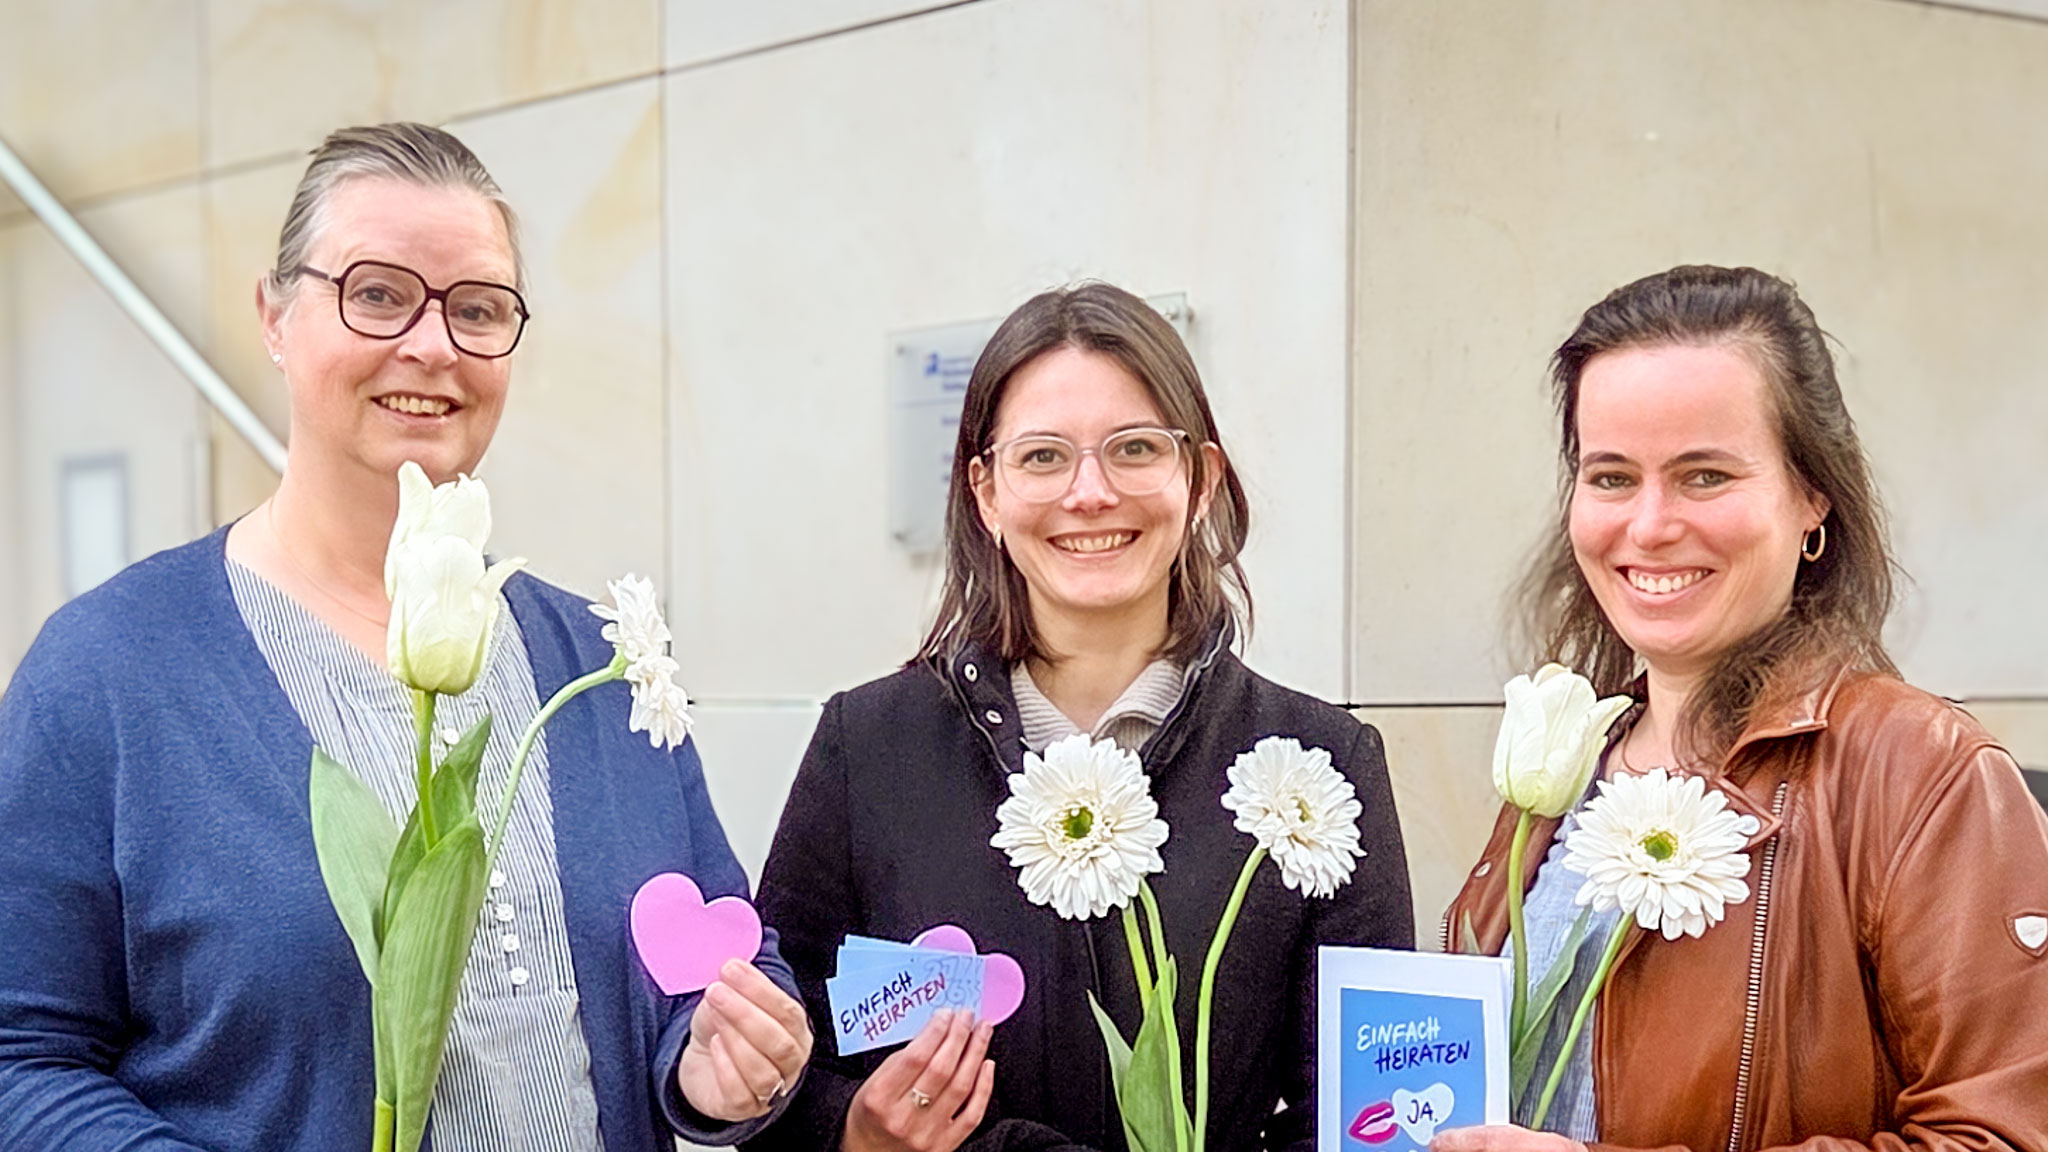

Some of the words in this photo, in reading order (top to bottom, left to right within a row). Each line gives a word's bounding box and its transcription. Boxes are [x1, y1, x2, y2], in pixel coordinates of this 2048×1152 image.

[840, 971, 912, 1034] EINFACH
[863, 972, 947, 1041] HEIRATEN
[1356, 1016, 1441, 1051] EINFACH
[1375, 1040, 1471, 1074] HEIRATEN
[1406, 1099, 1439, 1124] JA.
